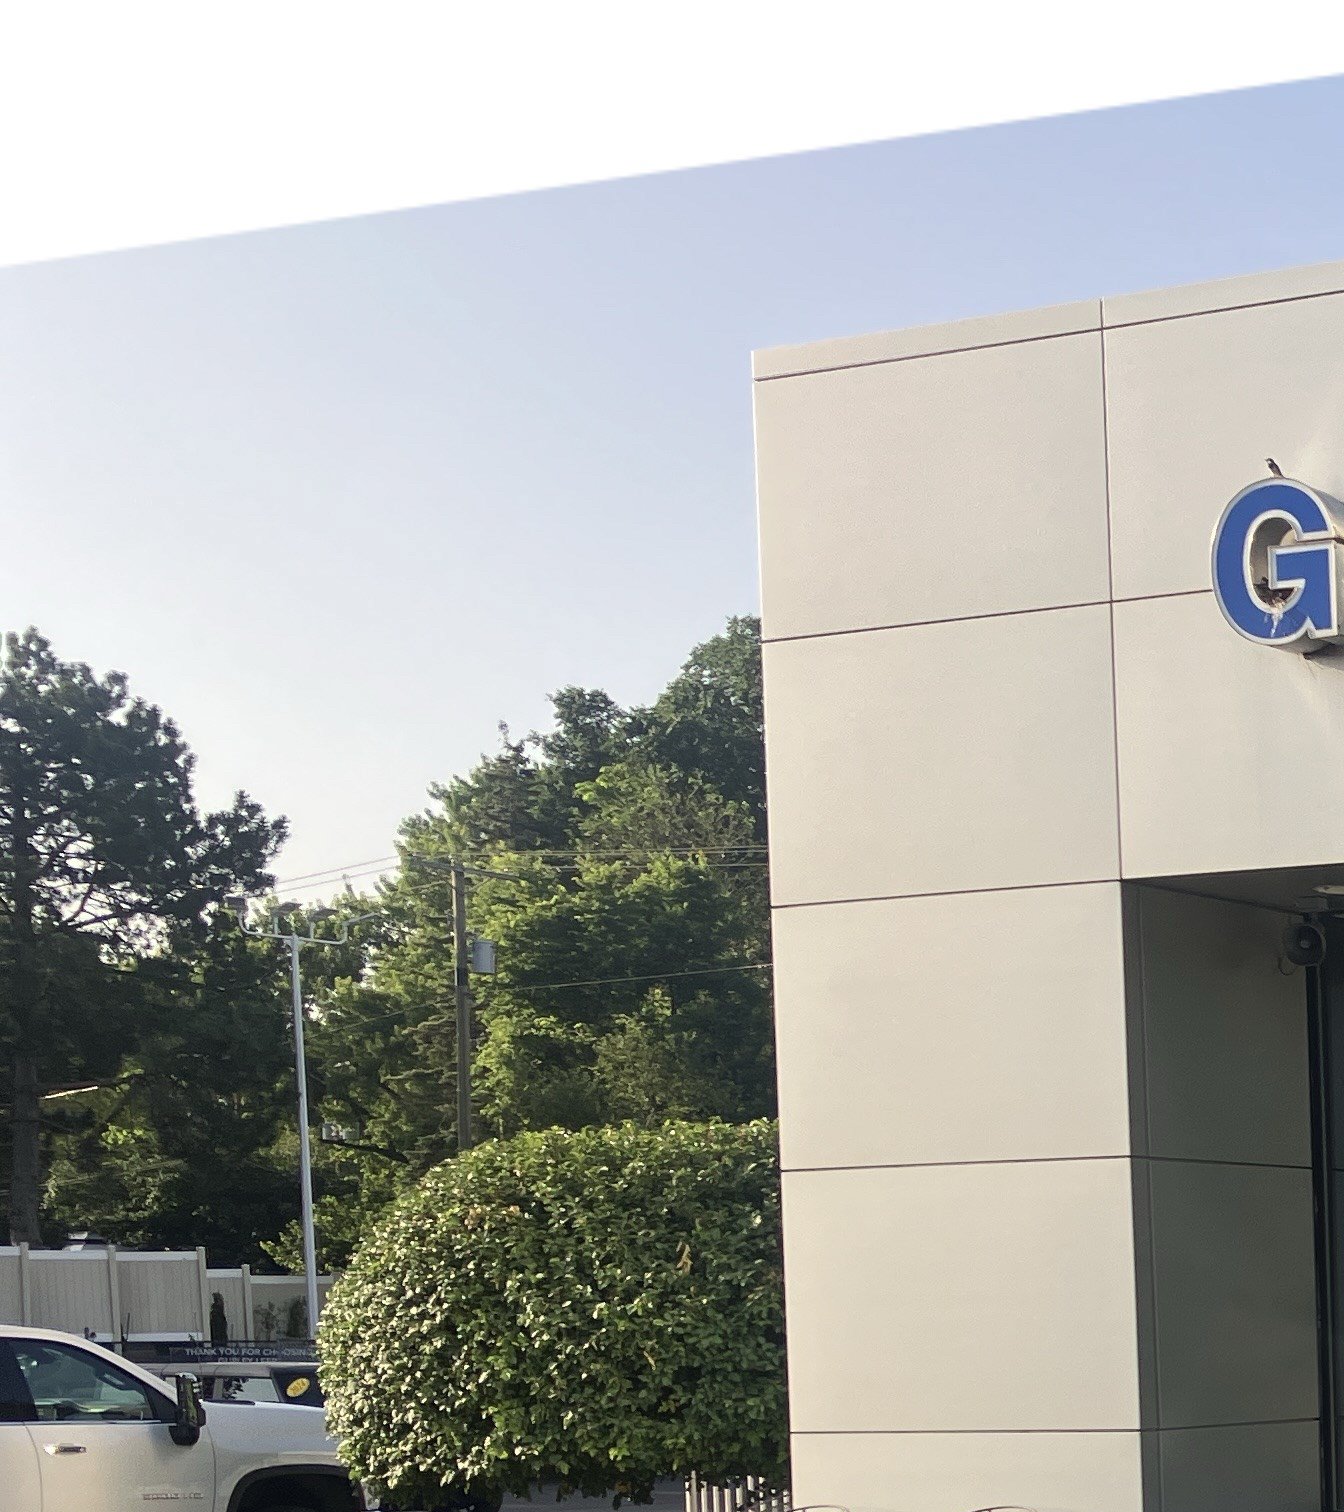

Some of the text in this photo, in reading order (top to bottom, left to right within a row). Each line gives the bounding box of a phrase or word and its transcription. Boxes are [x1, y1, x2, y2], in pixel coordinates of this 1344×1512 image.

[185, 1347, 217, 1356] THANK
[219, 1347, 239, 1356] YOU
[241, 1347, 261, 1356] FOR
